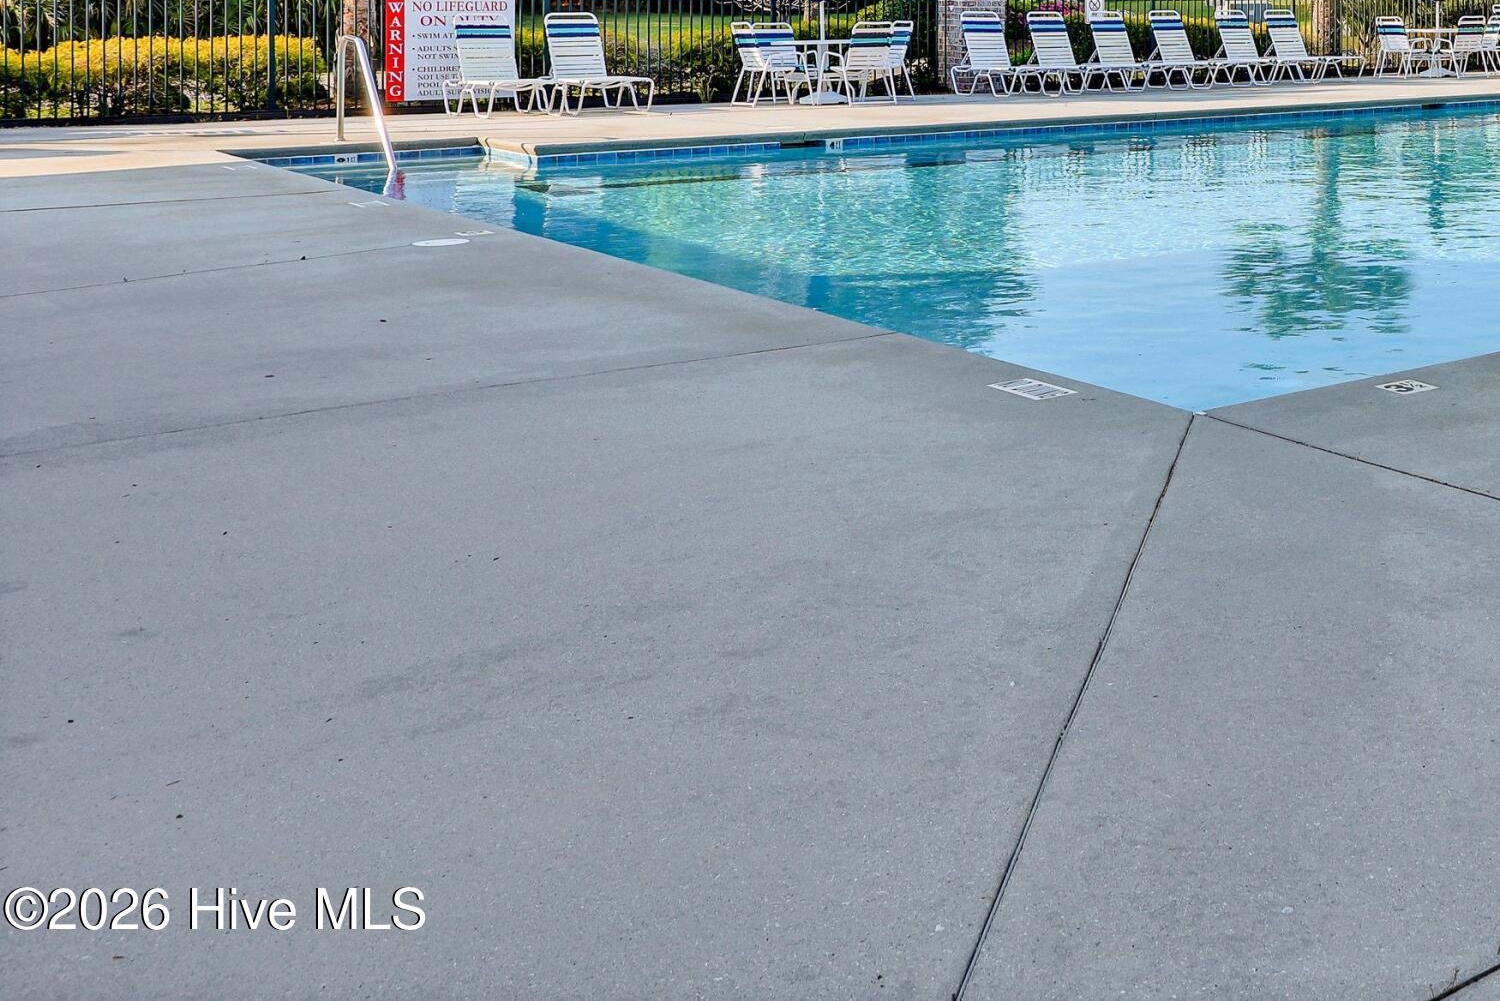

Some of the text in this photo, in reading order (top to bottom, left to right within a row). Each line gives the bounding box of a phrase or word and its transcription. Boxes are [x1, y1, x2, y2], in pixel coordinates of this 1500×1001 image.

[412, 1, 508, 12] NO LIFEGUARD
[420, 15, 446, 27] ON
[388, 2, 404, 97] WARNING
